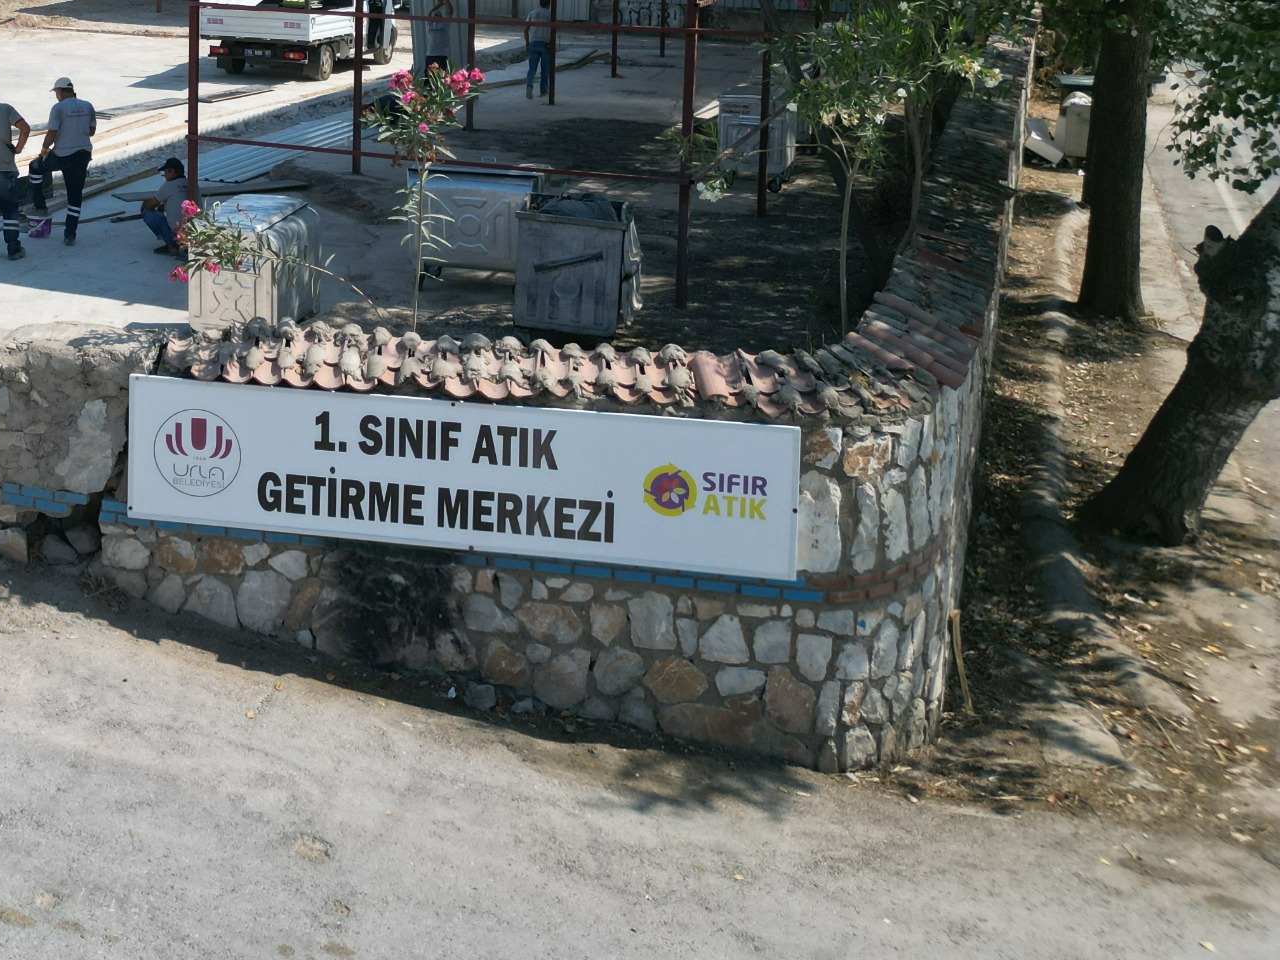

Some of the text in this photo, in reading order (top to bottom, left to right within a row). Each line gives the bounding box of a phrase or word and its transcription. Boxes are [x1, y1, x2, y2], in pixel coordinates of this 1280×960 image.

[314, 410, 559, 471] 1. SINIF ATIK
[257, 466, 615, 544] GETİRME MERKEZİ
[702, 472, 768, 497] SIFIR
[702, 493, 767, 521] ATIK
